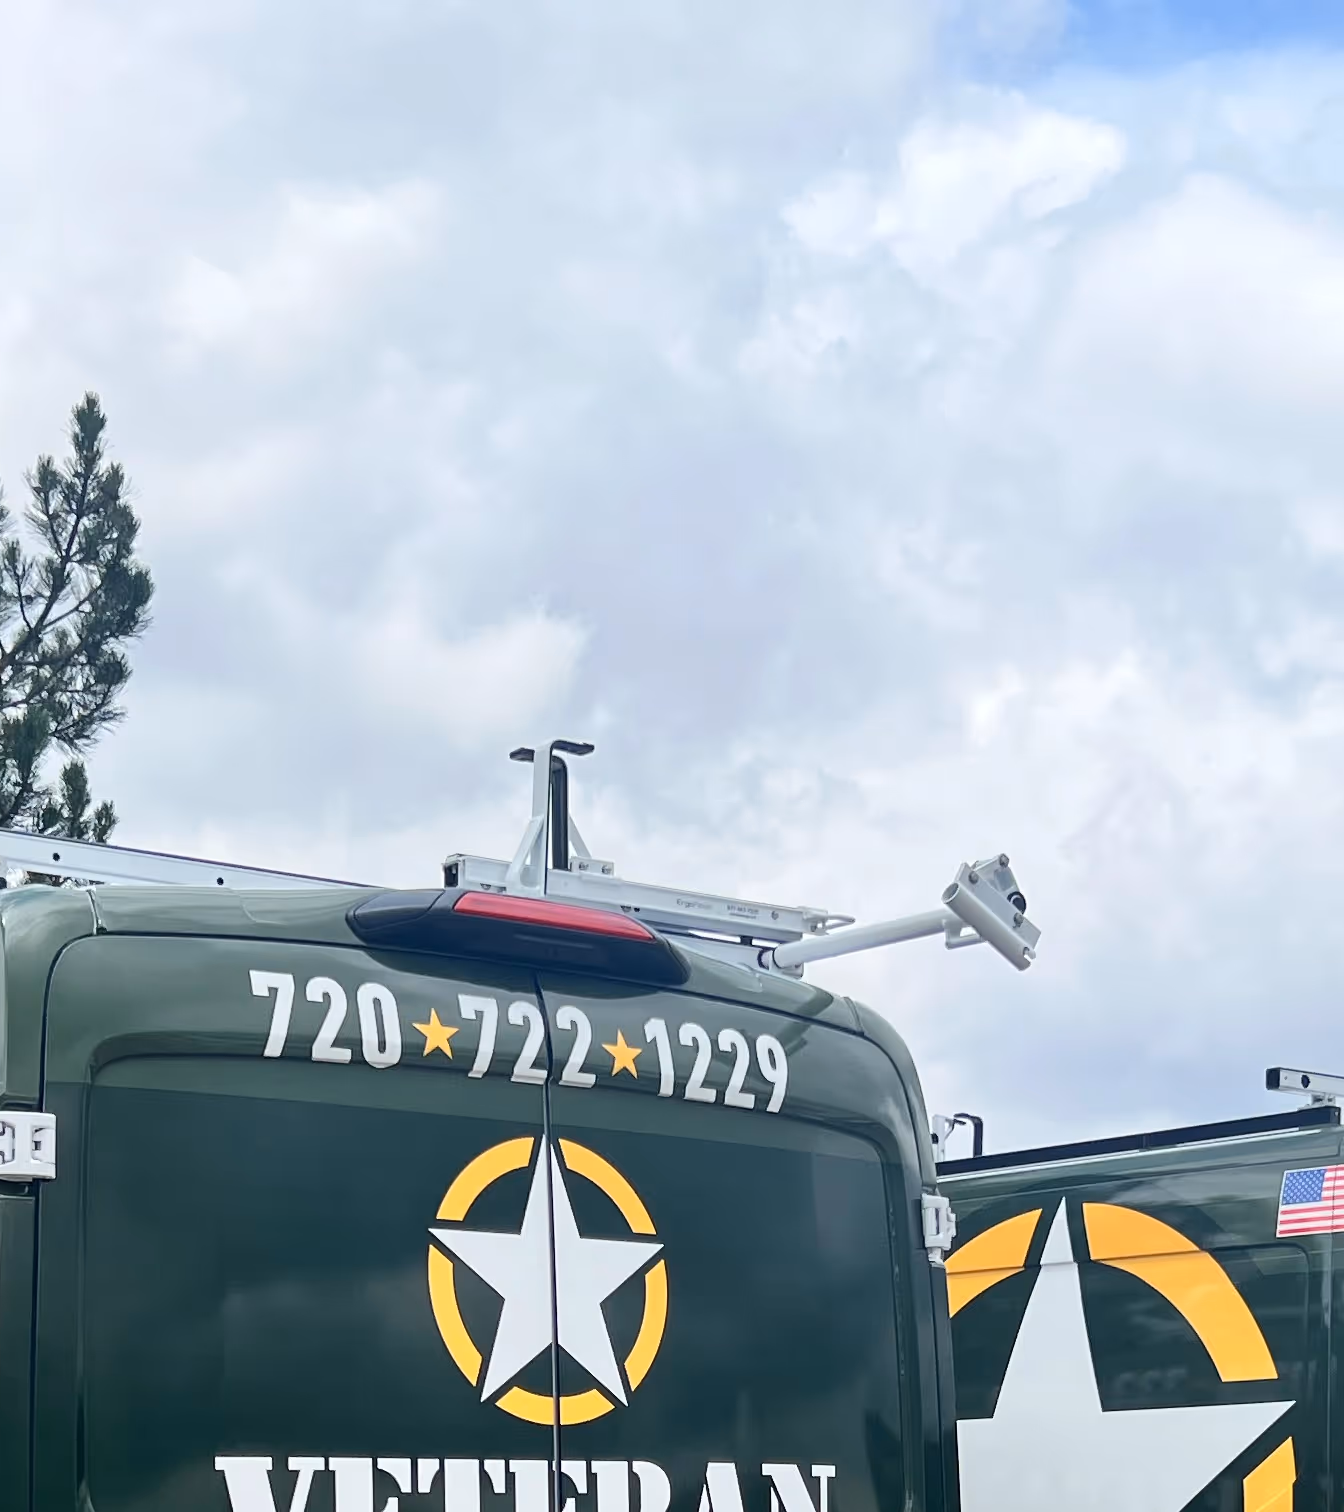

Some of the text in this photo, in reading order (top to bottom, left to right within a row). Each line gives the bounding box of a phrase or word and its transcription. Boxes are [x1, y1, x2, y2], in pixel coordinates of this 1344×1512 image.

[249, 970, 789, 1114] 720 722 1229
